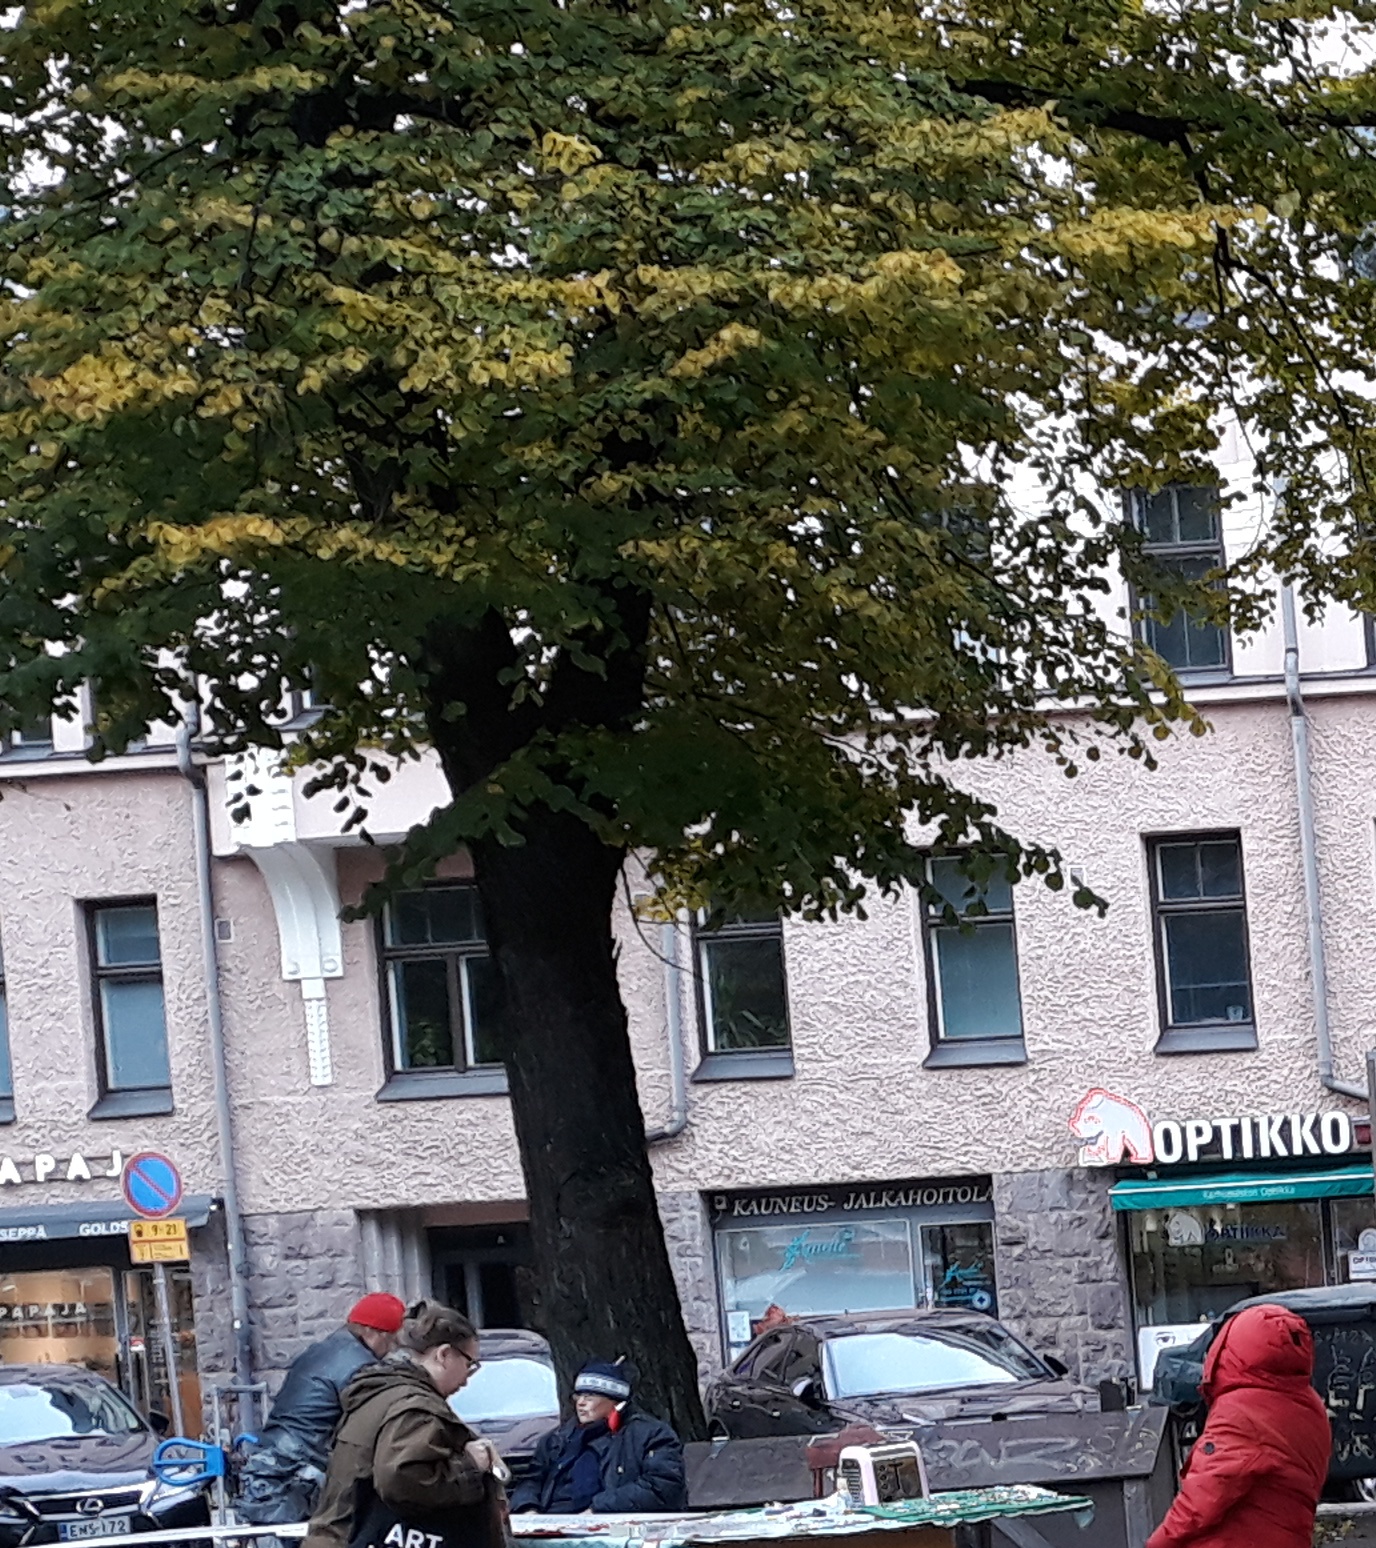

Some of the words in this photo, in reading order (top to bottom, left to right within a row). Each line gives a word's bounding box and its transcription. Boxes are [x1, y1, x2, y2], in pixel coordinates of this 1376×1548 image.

[1152, 1111, 1351, 1164] OPTIKKO
[733, 1195, 836, 1216] KAUNEUS-
[842, 1185, 994, 1211] JALKAHOITOLA
